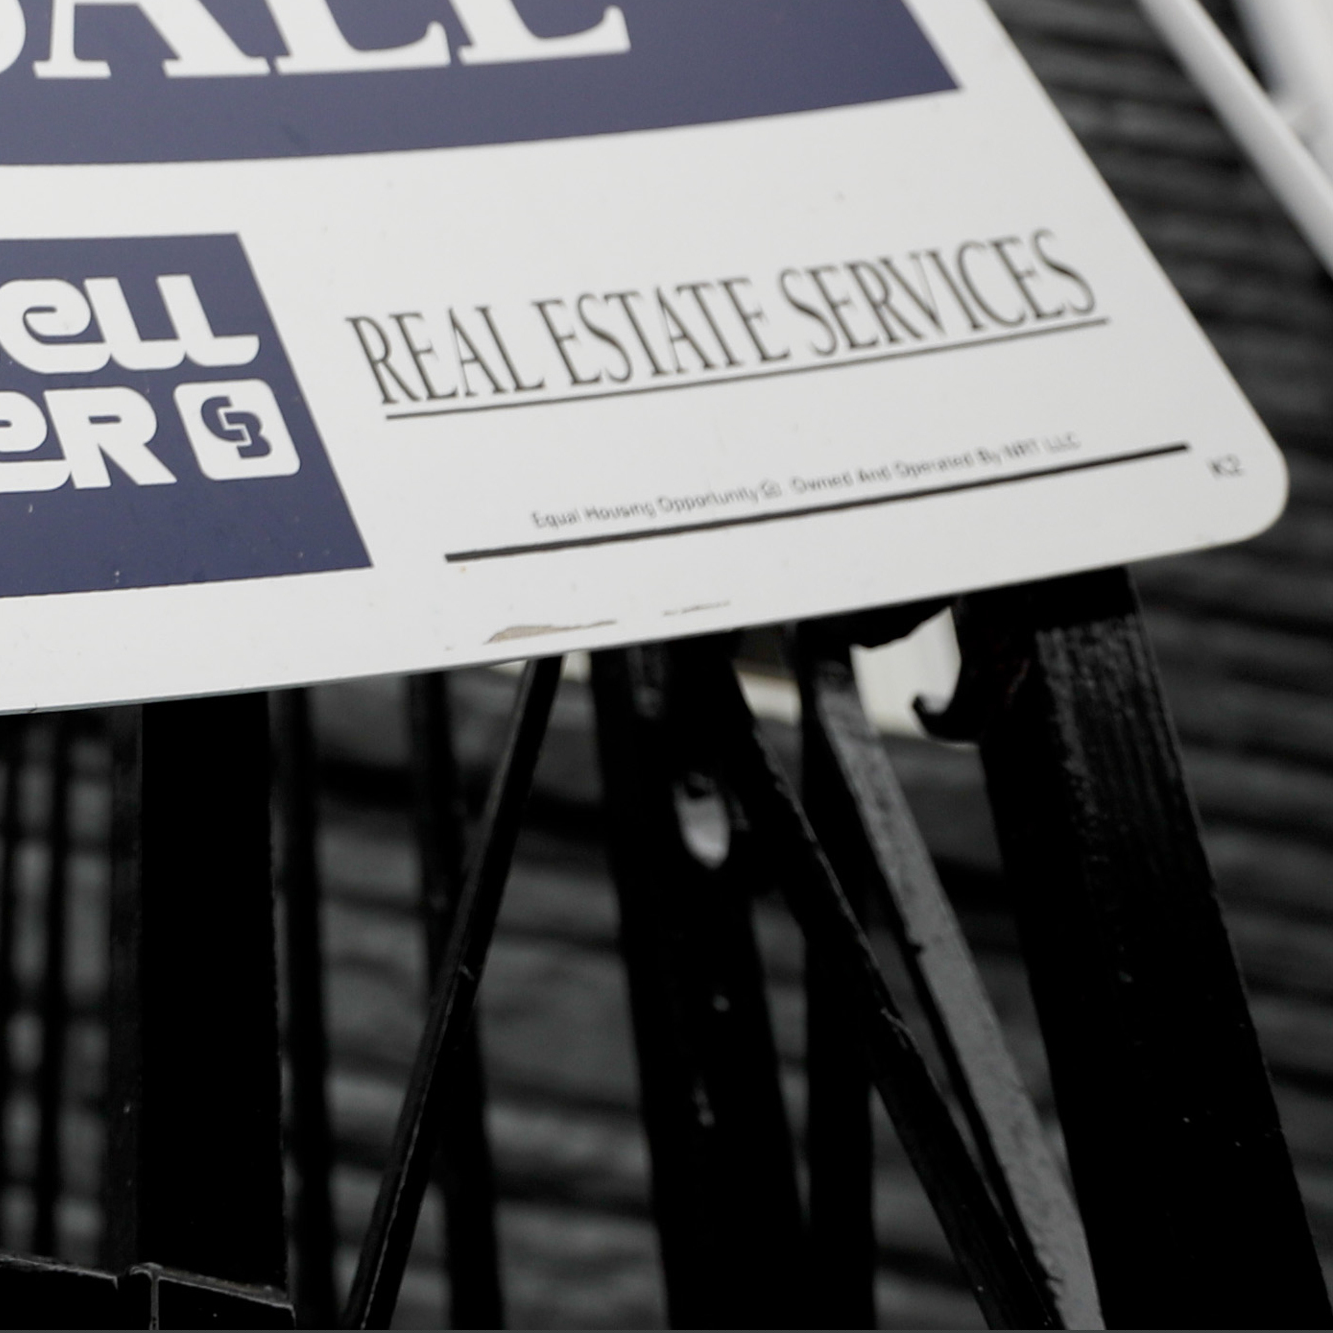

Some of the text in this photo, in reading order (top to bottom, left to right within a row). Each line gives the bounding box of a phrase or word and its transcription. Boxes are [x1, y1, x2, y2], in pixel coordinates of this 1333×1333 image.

[345, 229, 1099, 406] REAL ESTATE SERVICES
[531, 509, 582, 530] Equal
[585, 501, 656, 523] Housing
[657, 484, 761, 514] Opportunity
[790, 472, 853, 494] Owned
[894, 450, 975, 479] Operated
